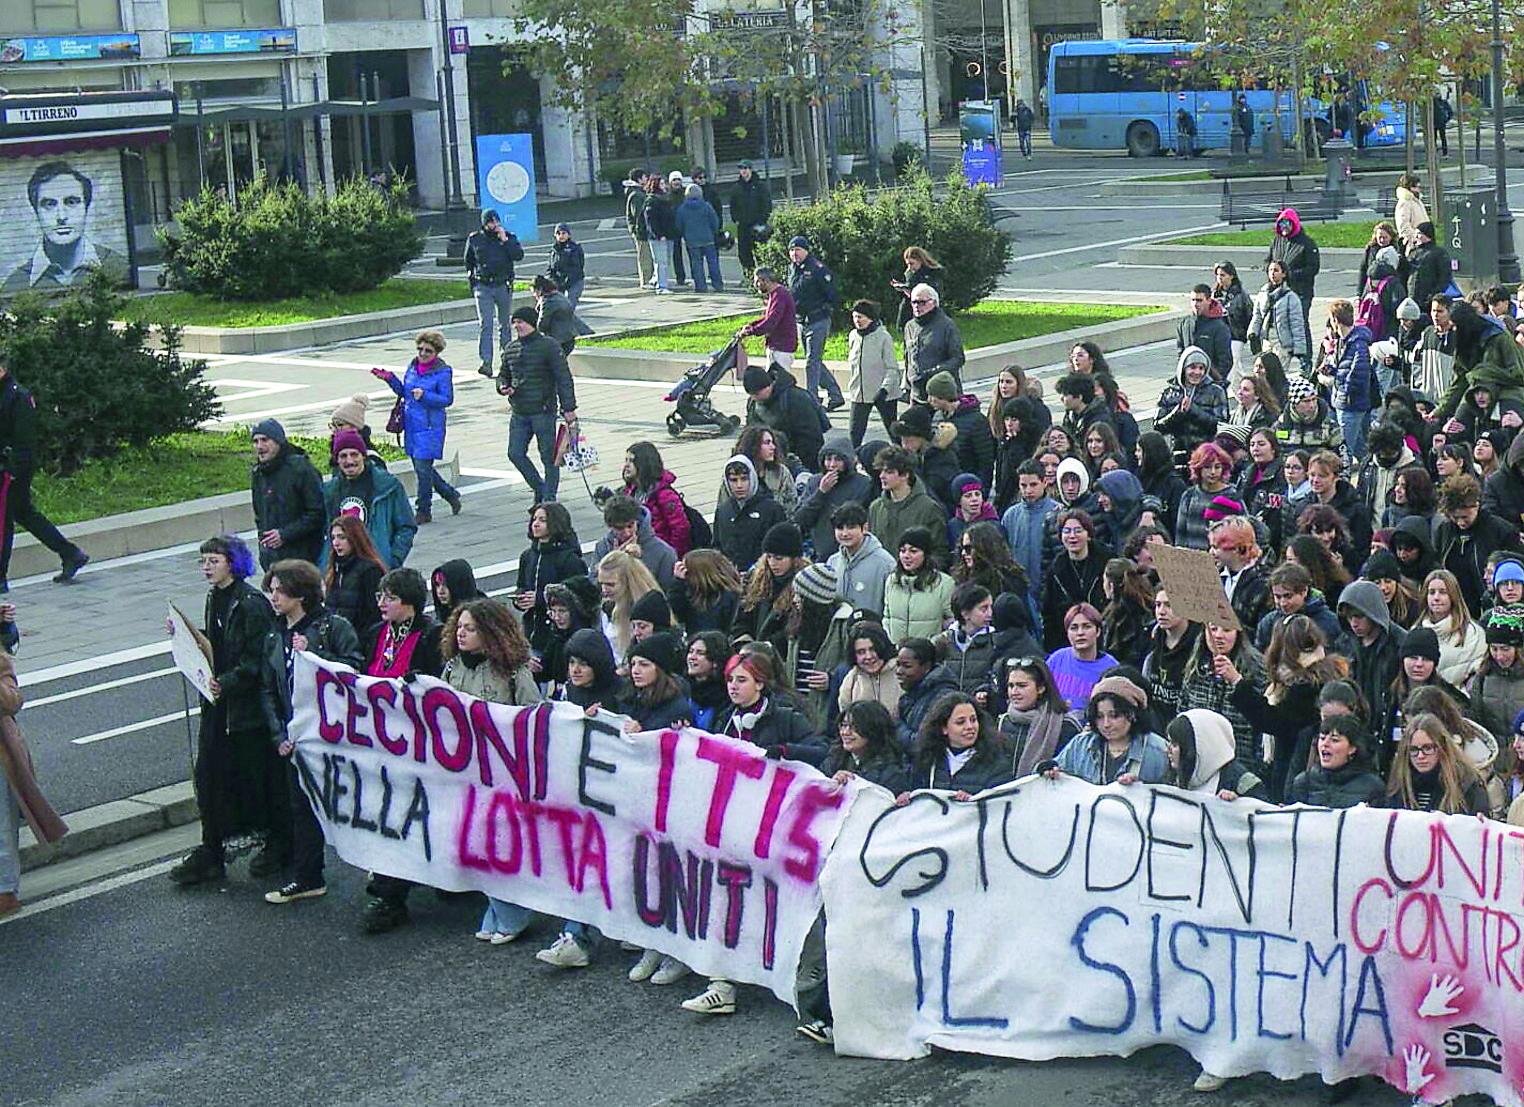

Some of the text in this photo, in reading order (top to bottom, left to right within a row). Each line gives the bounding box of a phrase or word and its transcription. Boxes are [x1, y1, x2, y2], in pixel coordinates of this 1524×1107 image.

[29, 106, 78, 121] TIRRENO
[315, 668, 844, 885] CECIONI E ITIS
[299, 752, 779, 970] NELLA LOTTA UNITI
[859, 787, 1348, 938] STUDENTI
[911, 904, 1396, 1059] IL SISTEMA
[1443, 1031, 1503, 1062] SDC
